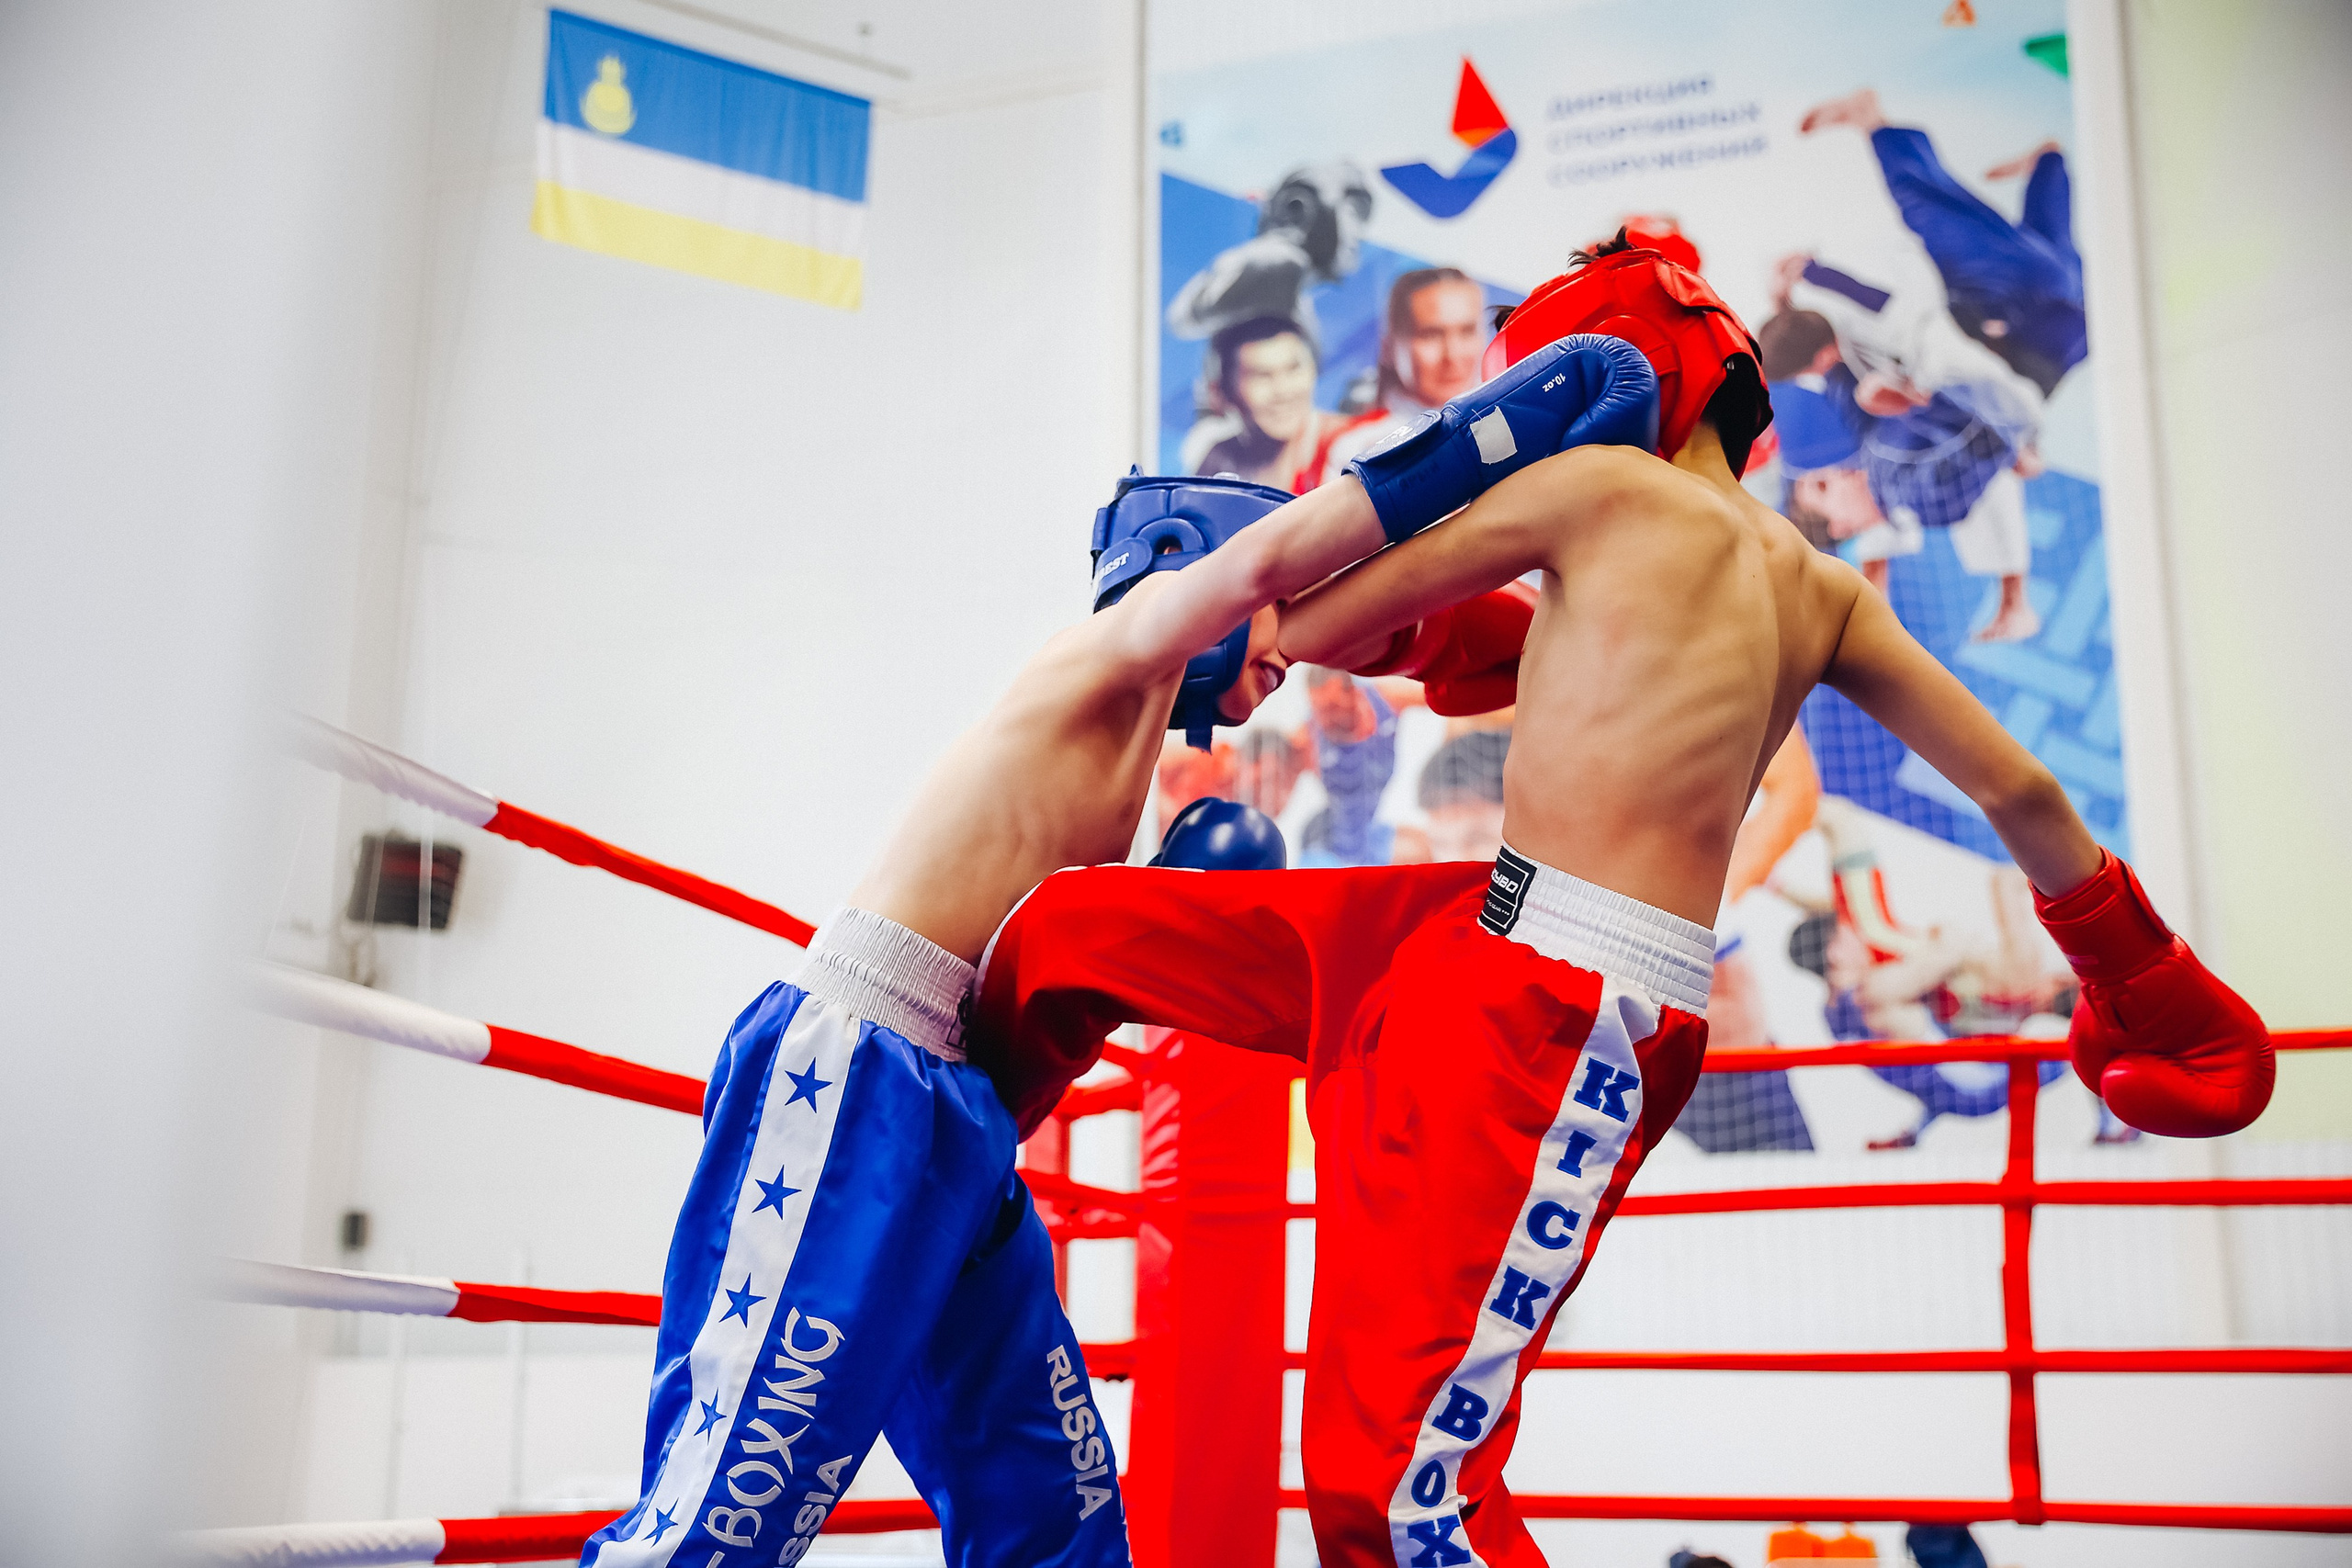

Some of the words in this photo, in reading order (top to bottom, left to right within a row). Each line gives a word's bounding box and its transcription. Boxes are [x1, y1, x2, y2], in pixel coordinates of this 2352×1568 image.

[1488, 1056, 1641, 1330] KICK
[778, 1454, 853, 1568] SSIA
[1046, 1344, 1113, 1521] RUSSIA
[1407, 1382, 1489, 1568] BOX
